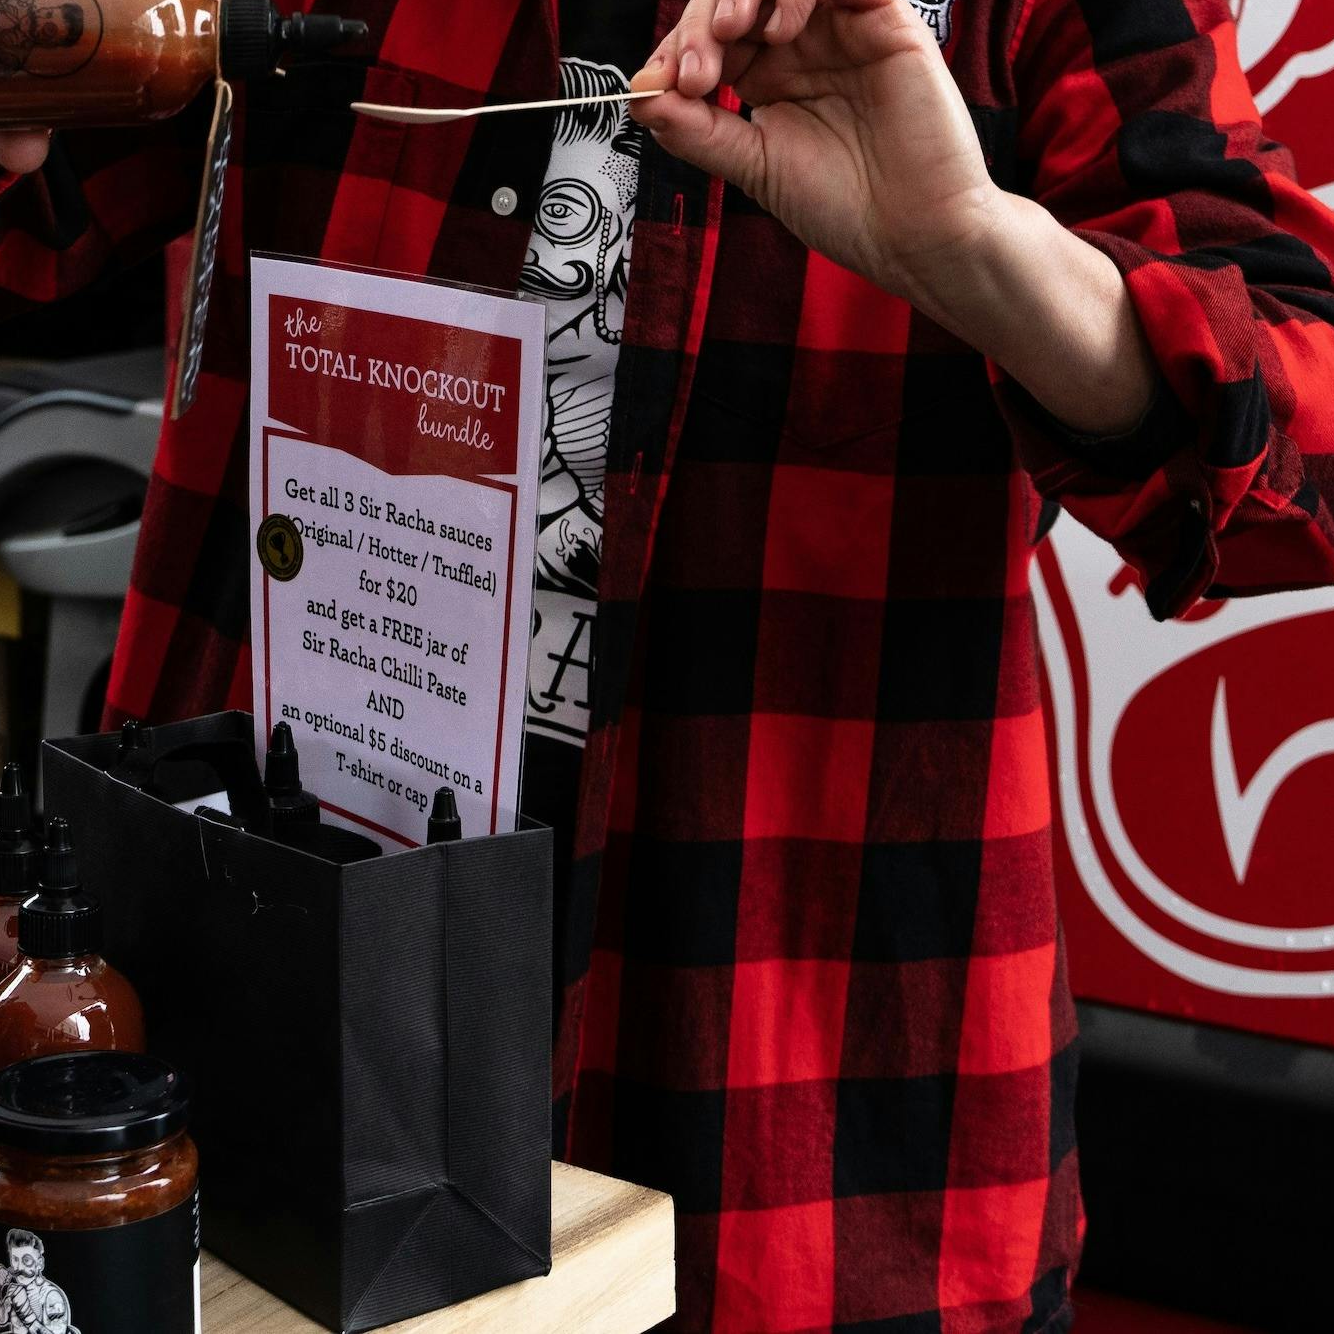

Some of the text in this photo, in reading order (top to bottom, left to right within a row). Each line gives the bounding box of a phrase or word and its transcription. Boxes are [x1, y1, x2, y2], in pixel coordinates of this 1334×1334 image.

[284, 307, 322, 338] the
[285, 342, 506, 413] TOTAL KNOCKOUT
[416, 403, 495, 451] bundle
[284, 478, 493, 552] Get all 3 Sir Racha sauces
[286, 514, 497, 598] Original / Hotter / Truffled)
[359, 569, 418, 607] for $20
[307, 599, 469, 665] and get a FREE jar of
[302, 630, 467, 706] Sir Racha Chilli Paste
[366, 689, 404, 720] AND
[281, 703, 483, 795] an optional $5 discount on a
[336, 751, 428, 812] T-shirt or cap
